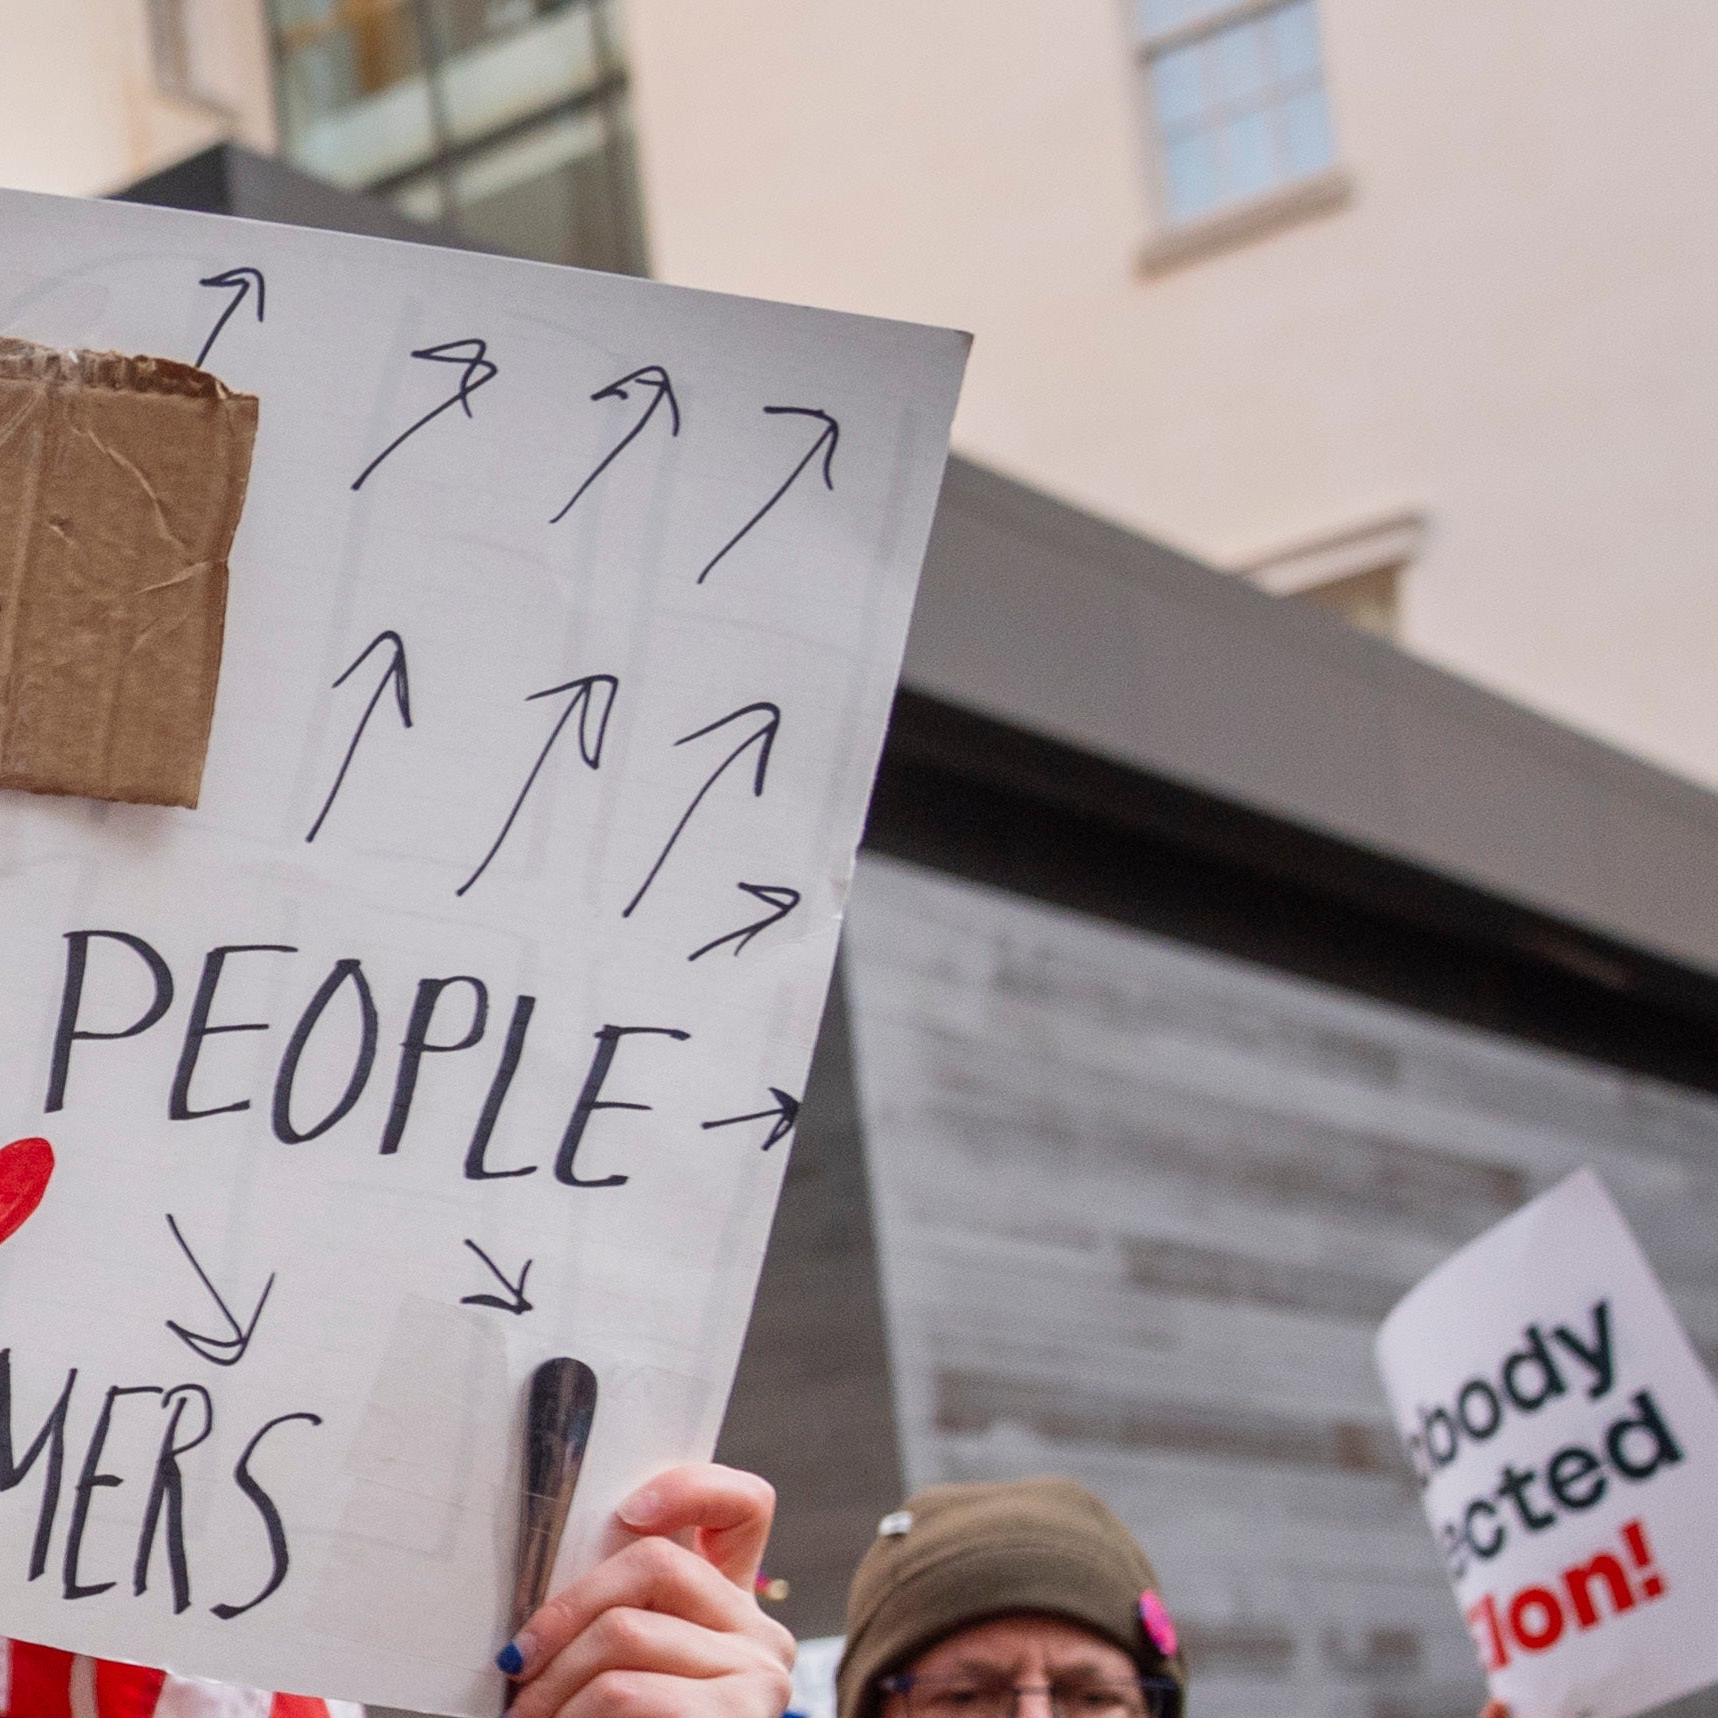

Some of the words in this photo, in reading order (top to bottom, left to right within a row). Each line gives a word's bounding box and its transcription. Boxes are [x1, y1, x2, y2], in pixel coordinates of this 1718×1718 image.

[45, 927, 691, 1187] PEOPLE
[1414, 1300, 1614, 1470] body
[1444, 1388, 1682, 1575] cted
